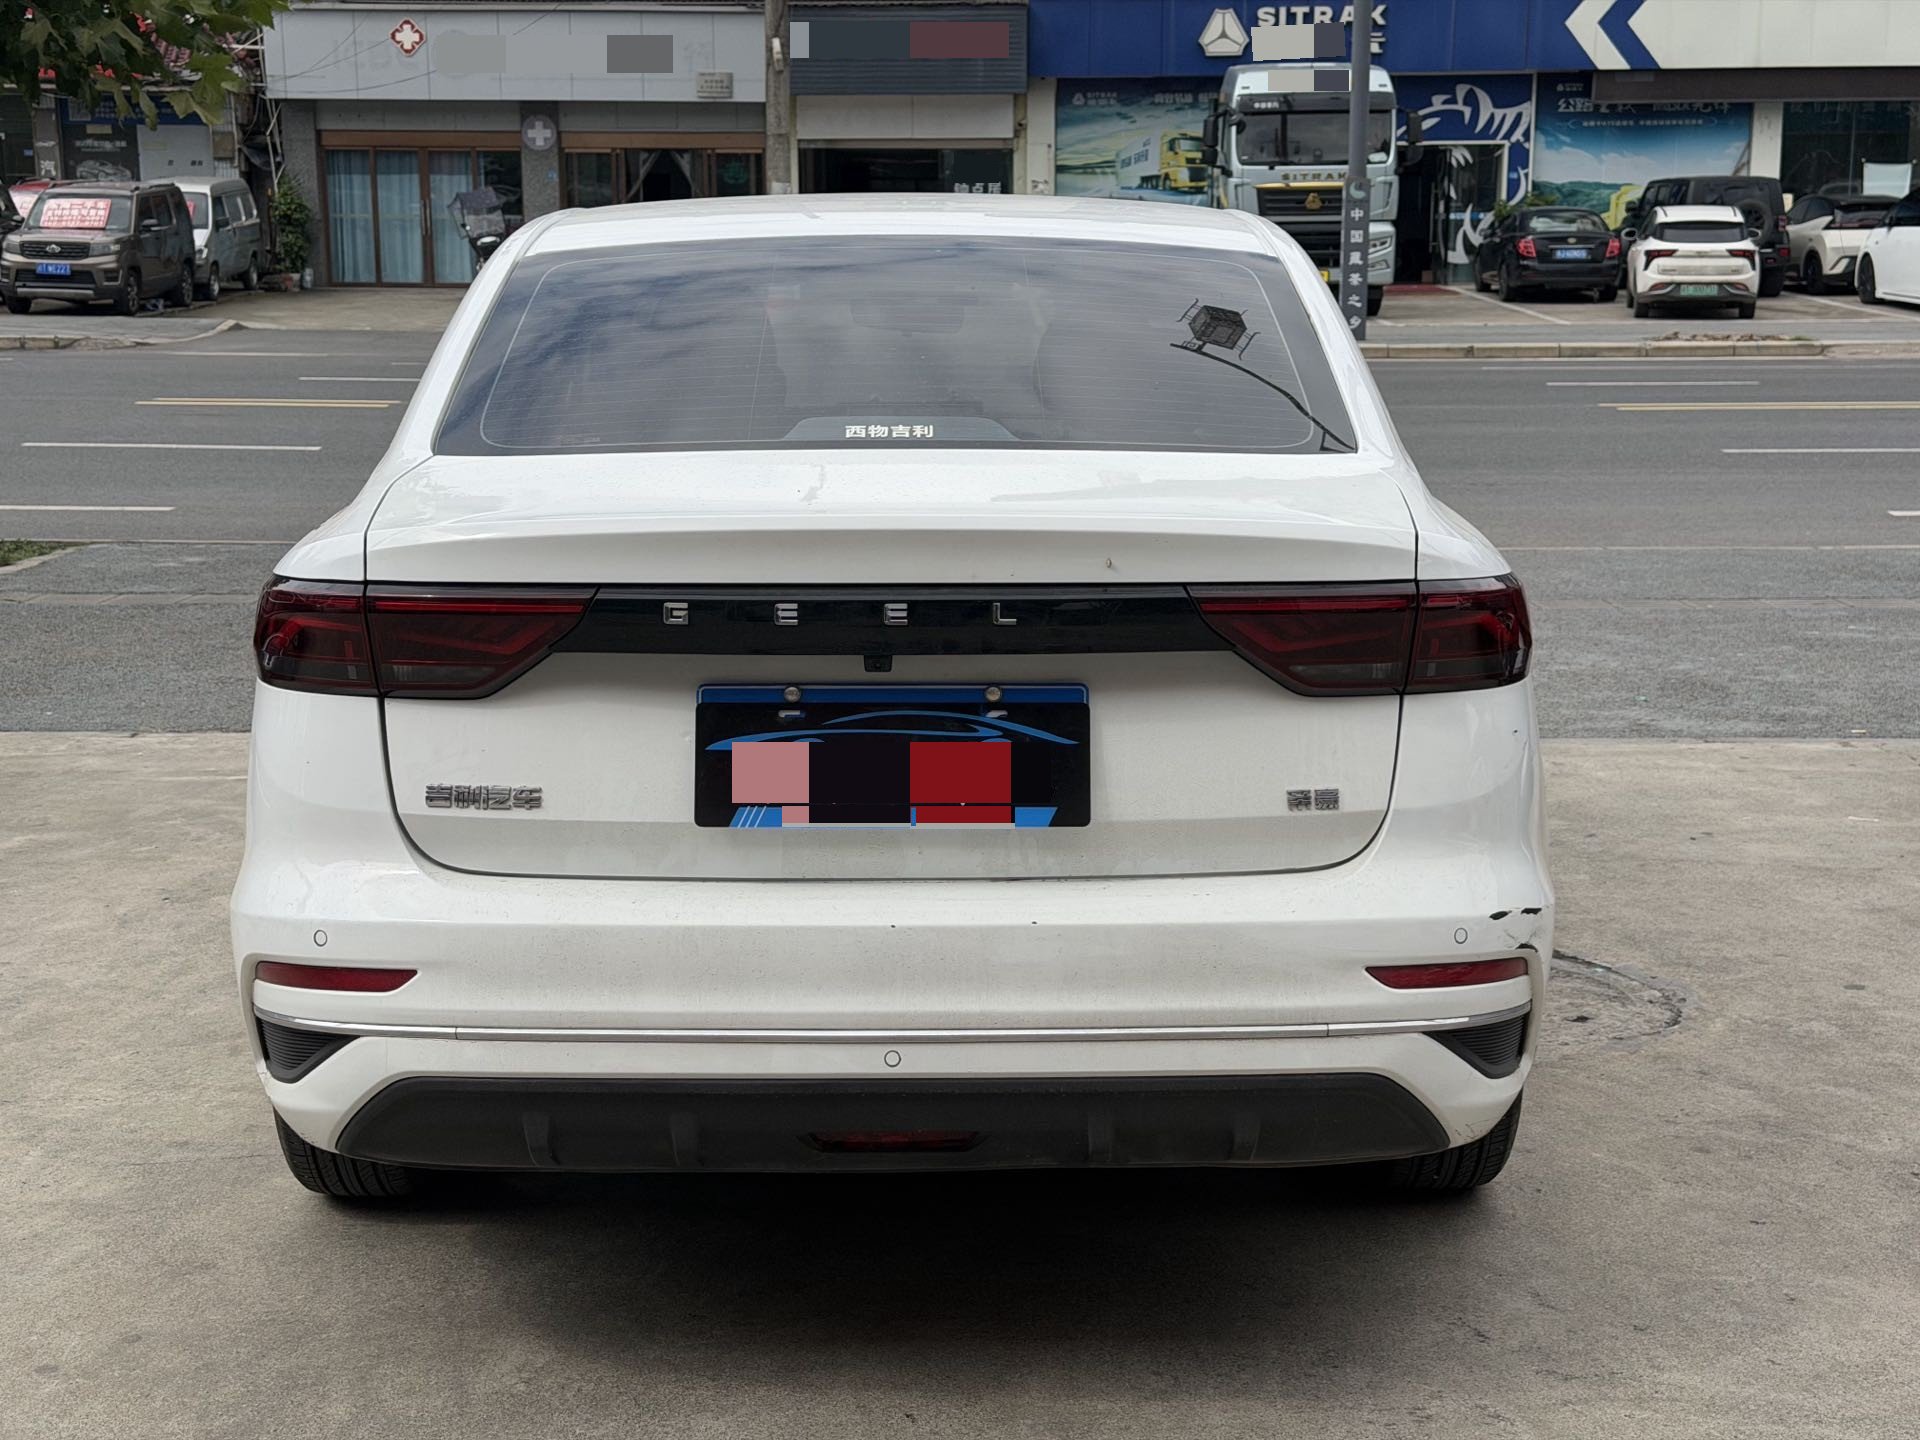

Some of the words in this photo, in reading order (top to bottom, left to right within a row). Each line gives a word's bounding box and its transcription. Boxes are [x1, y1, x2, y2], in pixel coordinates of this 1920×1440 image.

[845, 424, 934, 438] 西物吉利
[425, 784, 543, 810] 吉利汽车
